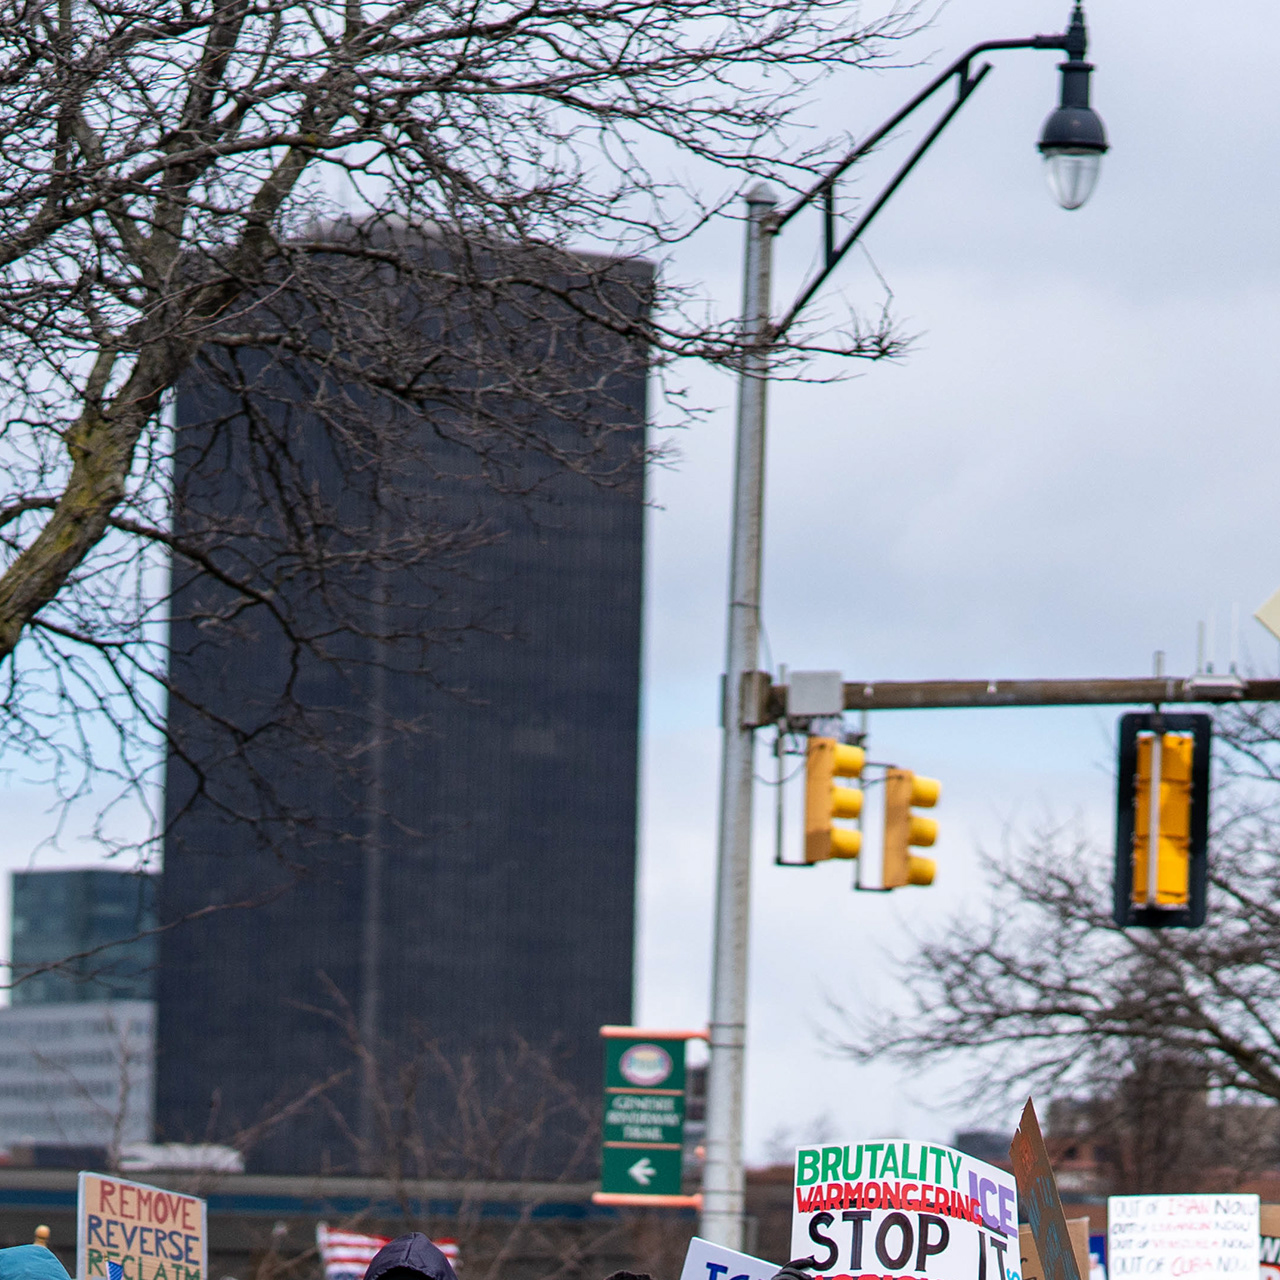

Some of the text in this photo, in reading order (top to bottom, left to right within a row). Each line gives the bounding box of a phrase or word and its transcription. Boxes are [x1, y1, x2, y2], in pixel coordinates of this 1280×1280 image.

[797, 1143, 962, 1189] BRUTALITY
[100, 1180, 196, 1231] REMOVE
[796, 1182, 983, 1227] WARMONGERING
[968, 1170, 1017, 1239] ICE
[1214, 1199, 1258, 1216] NOW
[88, 1214, 200, 1266] REVERSE
[809, 1211, 950, 1272] STOP
